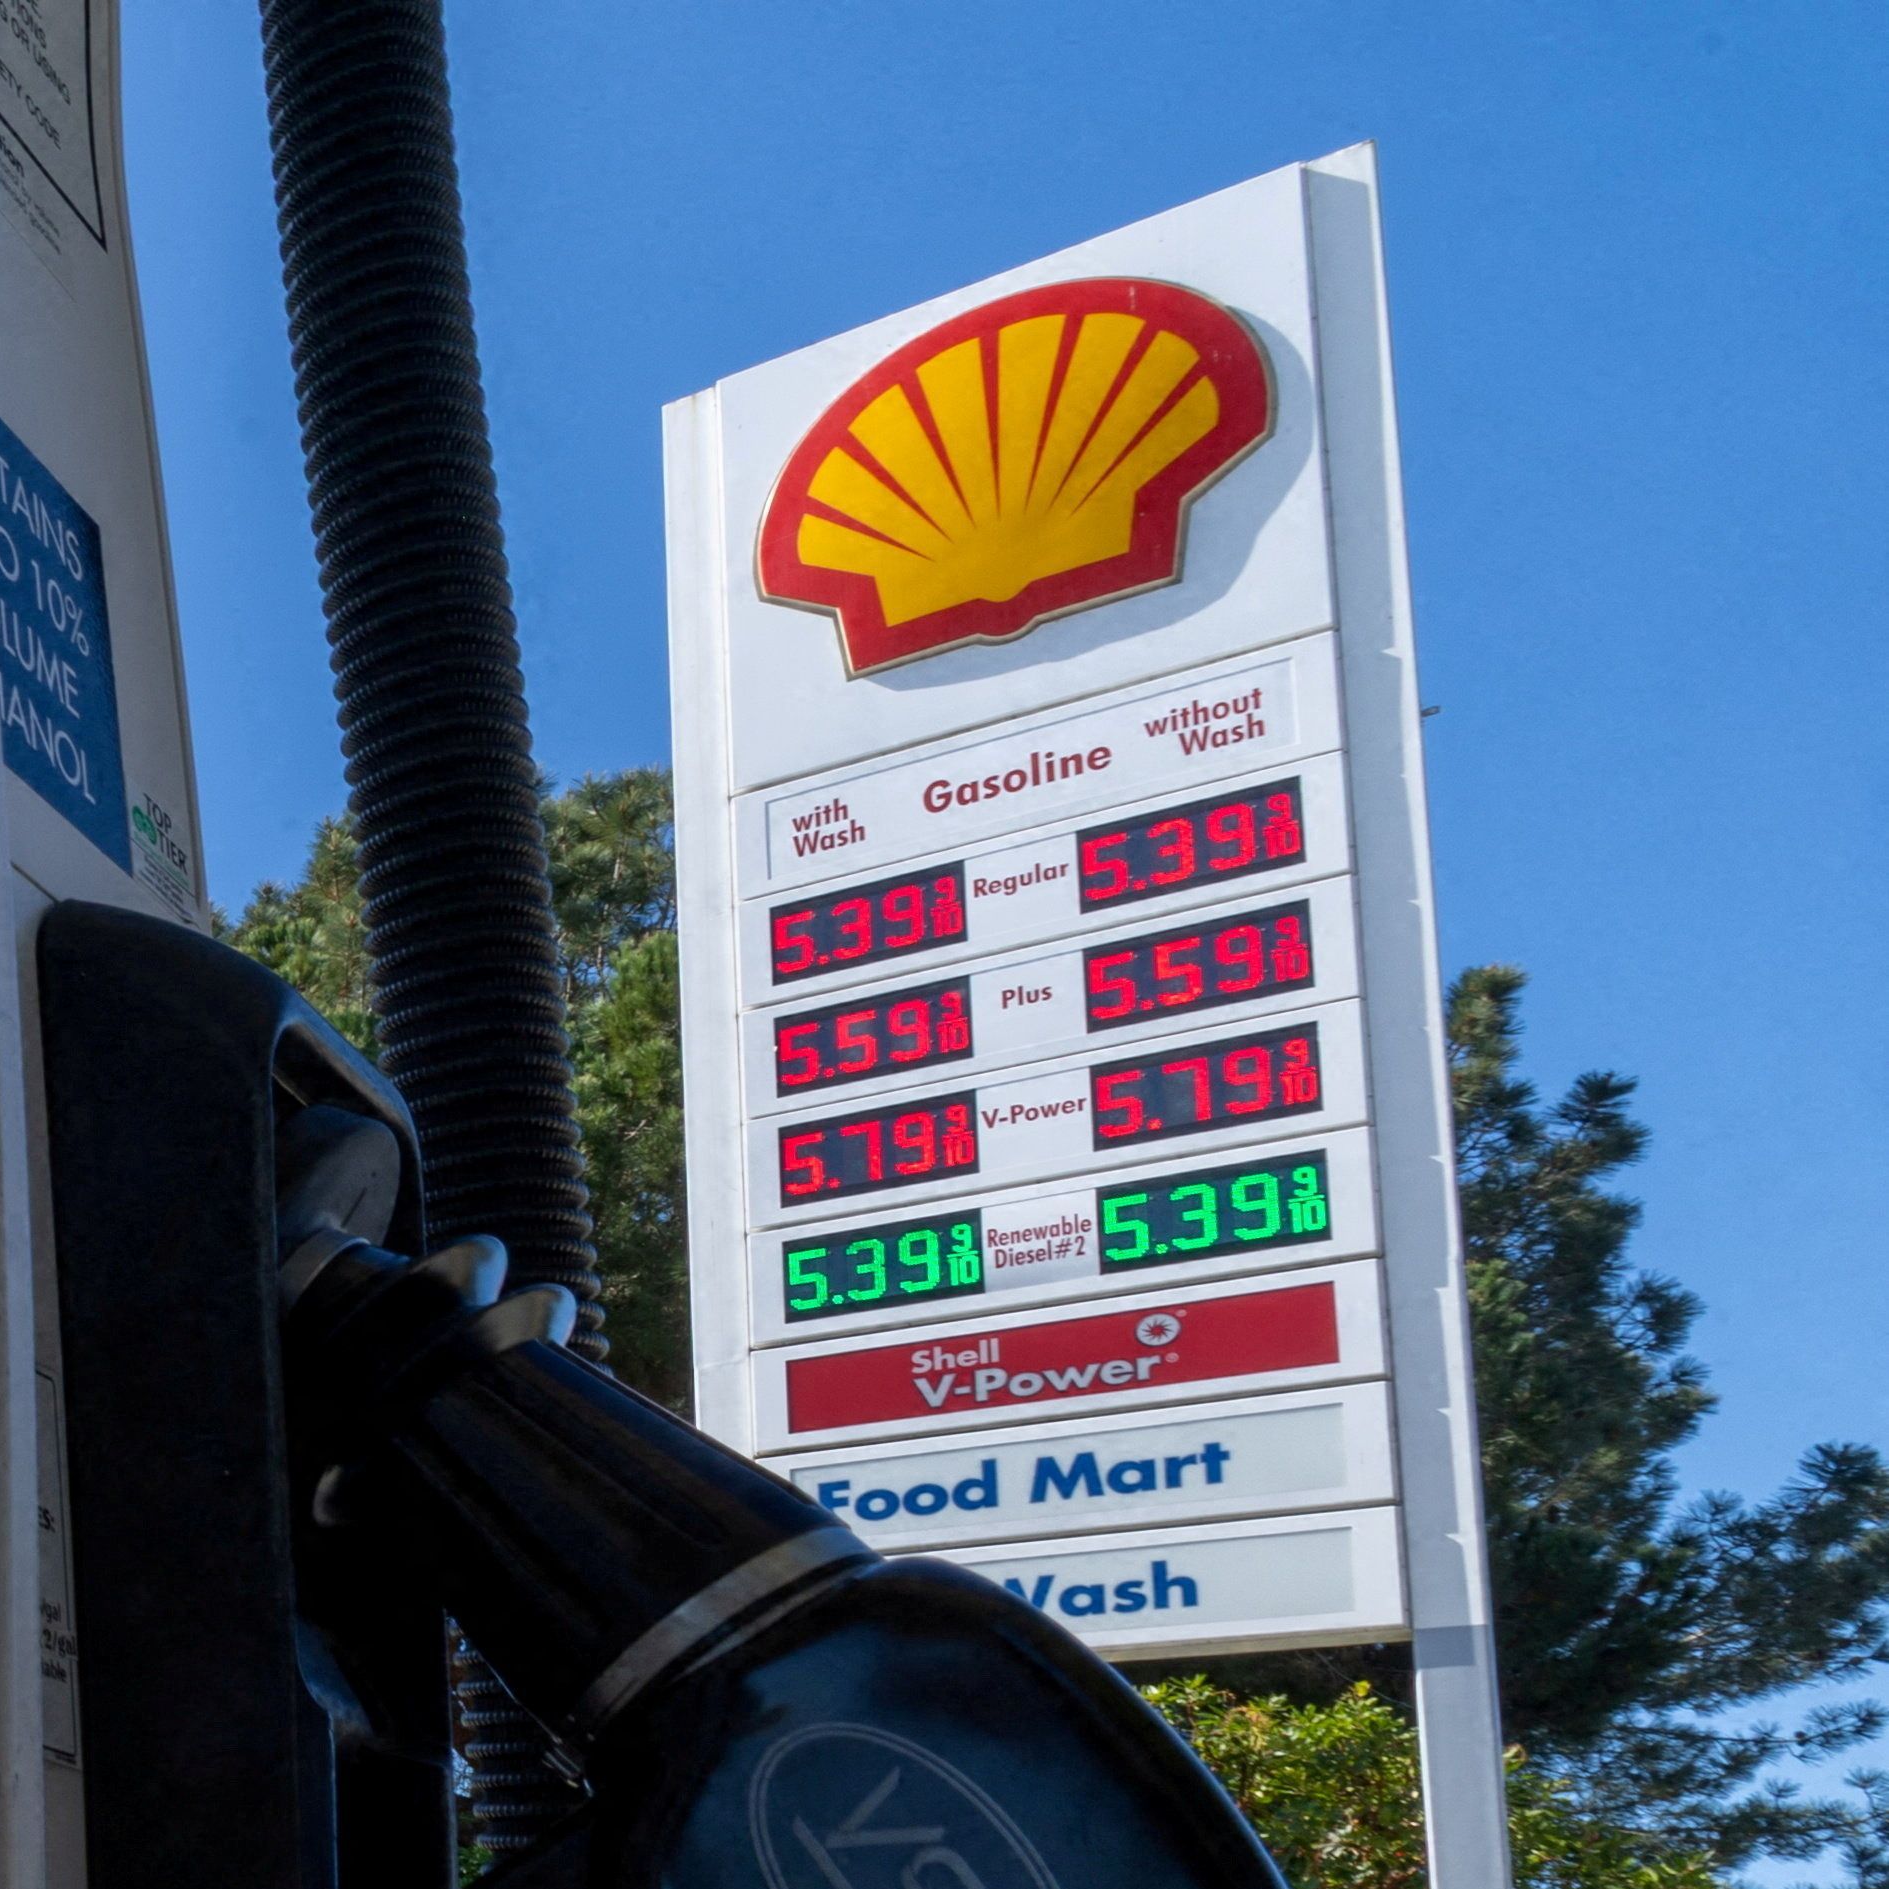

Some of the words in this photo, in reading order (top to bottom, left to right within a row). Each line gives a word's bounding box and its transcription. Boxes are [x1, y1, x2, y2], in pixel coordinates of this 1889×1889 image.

[31, 559, 90, 657] 10%
[1144, 688, 1262, 738] without
[1178, 714, 1265, 756] Wash
[922, 745, 1112, 813] Gasoline
[143, 792, 172, 834] TOP
[792, 798, 849, 833] with
[157, 828, 188, 875] TIER
[793, 821, 866, 857] Wash
[973, 861, 1069, 898] Regular
[1001, 984, 1052, 1009] Plus
[982, 1096, 1087, 1129] V-Power
[987, 1216, 1092, 1248] Renewable
[912, 1338, 1000, 1374] Shell
[914, 1353, 1162, 1408] V-Power
[817, 1459, 1000, 1521] Food
[1029, 1441, 1230, 1504] Mart
